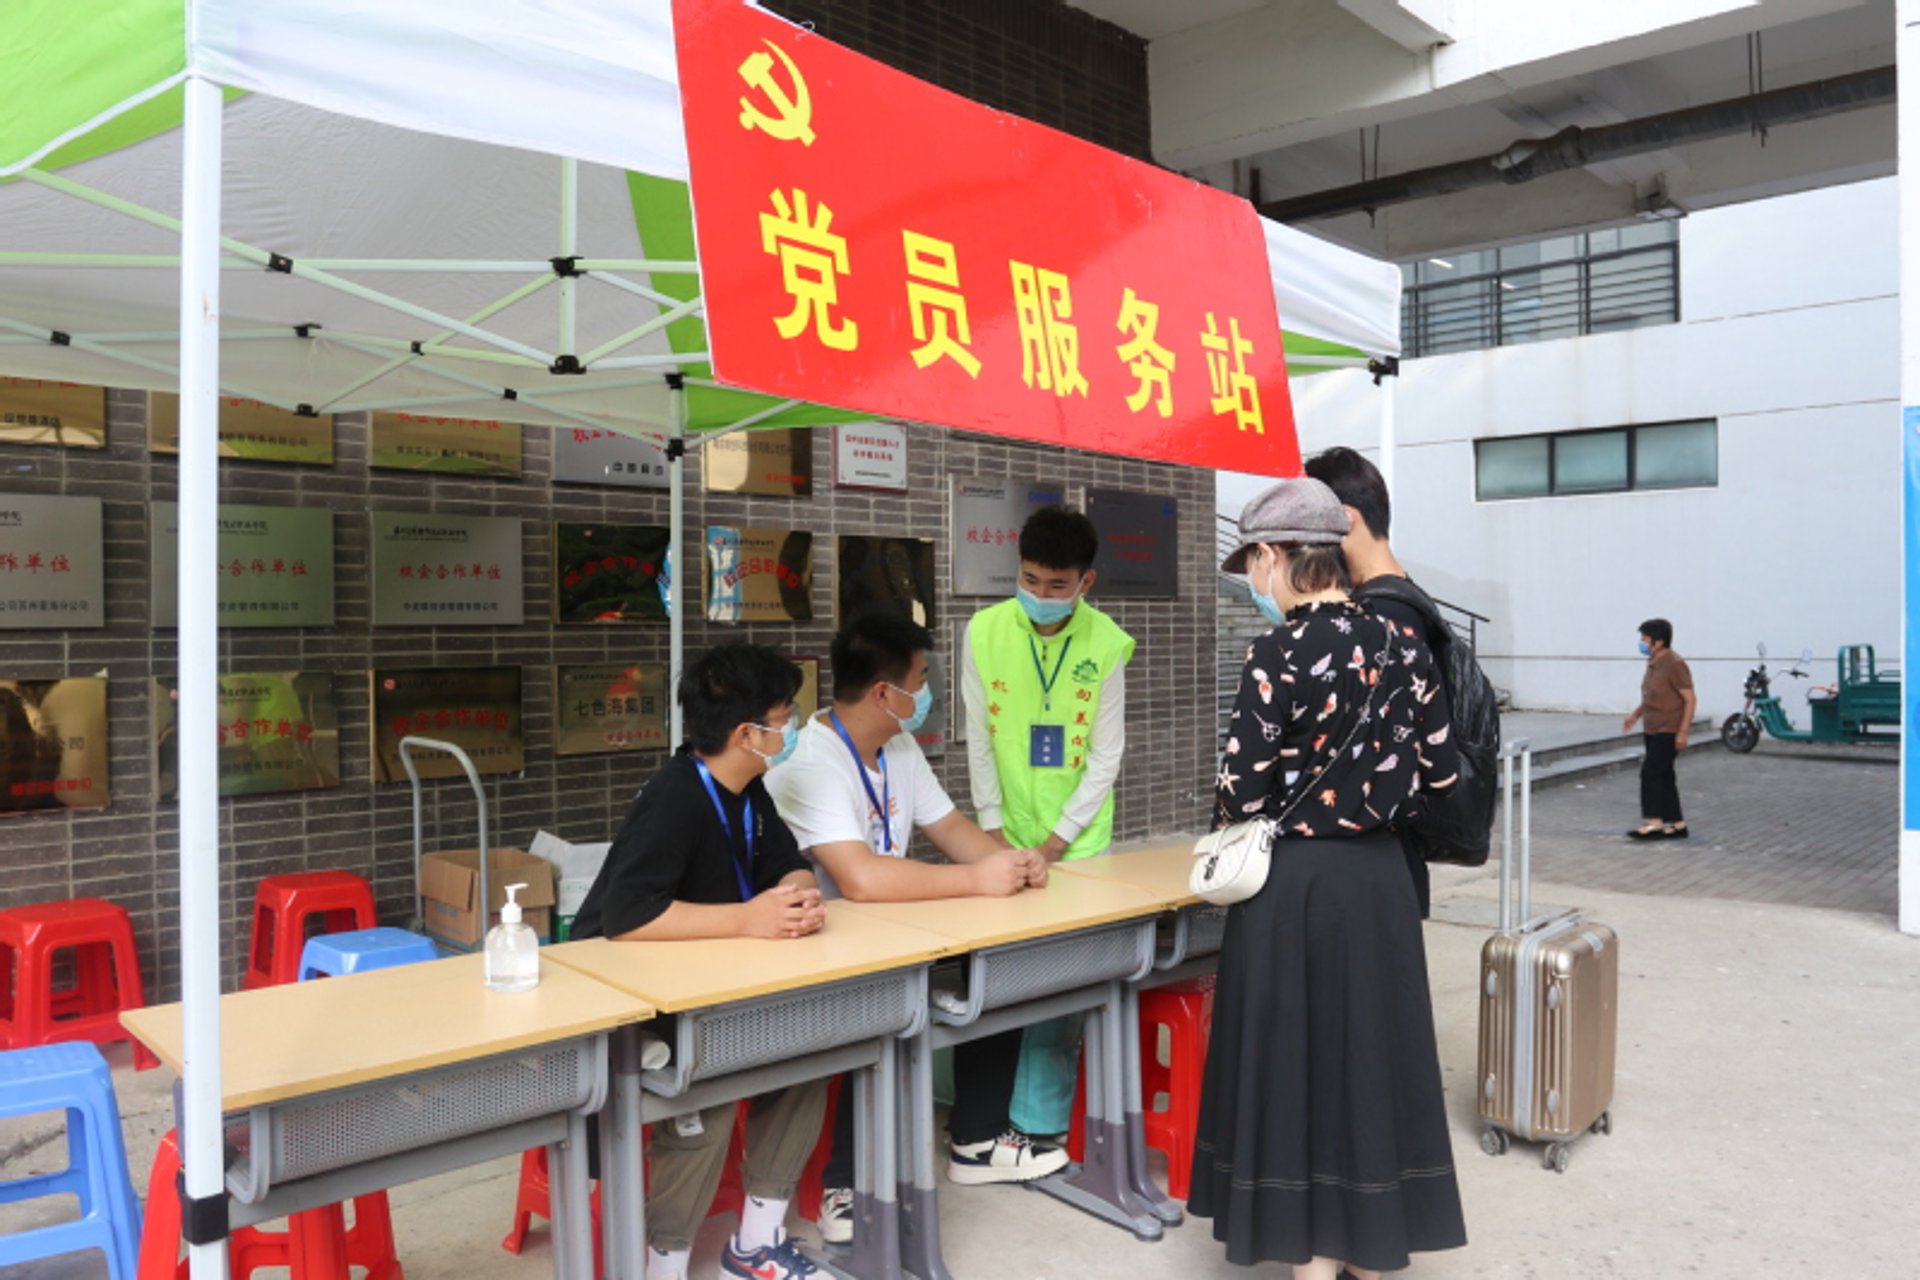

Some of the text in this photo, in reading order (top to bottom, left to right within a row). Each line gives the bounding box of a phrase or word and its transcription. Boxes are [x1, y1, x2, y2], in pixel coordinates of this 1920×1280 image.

[758, 187, 1265, 434] 党员服务站
[399, 562, 502, 580] 校企合作单位
[573, 695, 656, 717] 七色海集团
